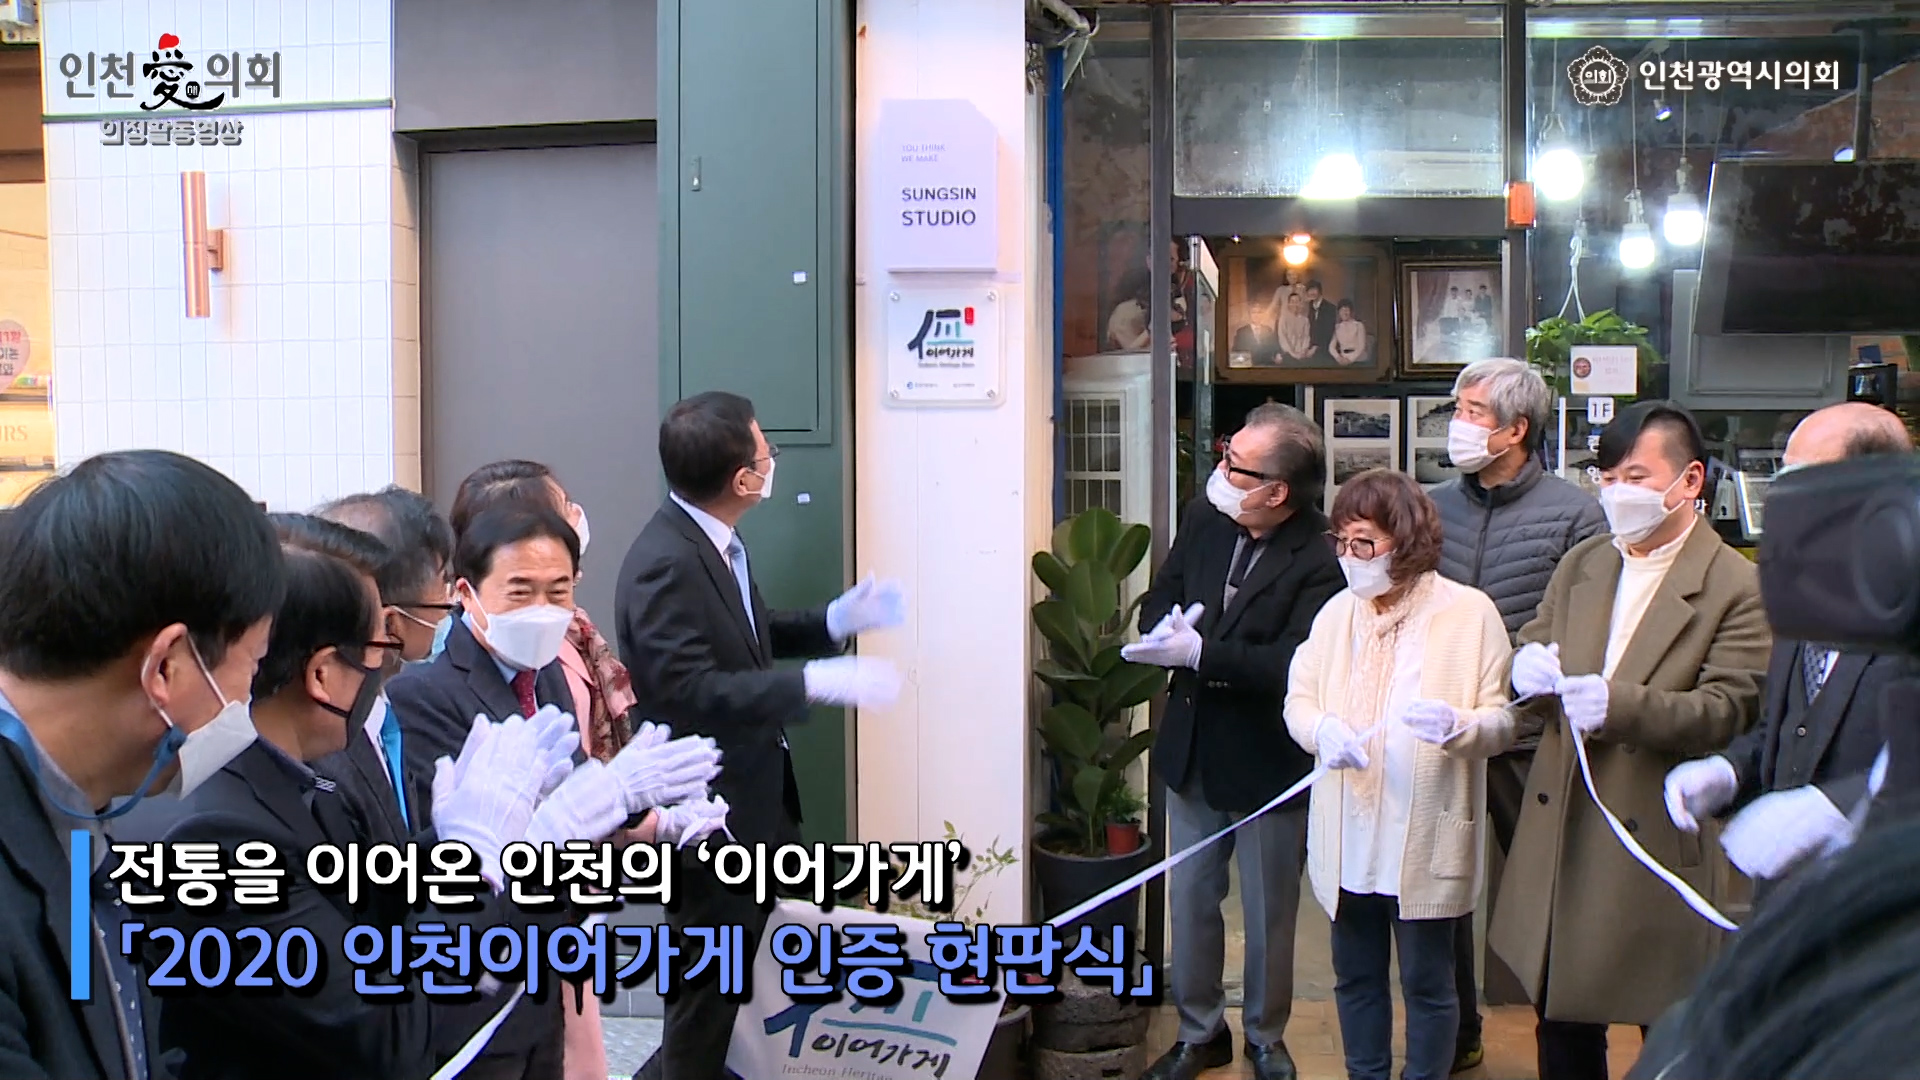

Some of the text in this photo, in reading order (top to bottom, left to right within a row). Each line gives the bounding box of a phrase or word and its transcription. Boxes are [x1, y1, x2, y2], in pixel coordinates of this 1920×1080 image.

[901, 187, 977, 201] SUNGSIN
[901, 209, 977, 226] STUDIO
[925, 347, 975, 359] 이어가게
[1592, 403, 1611, 417] 1F
[811, 1033, 951, 1079] 이어가게
[782, 1063, 836, 1077] Incheon
